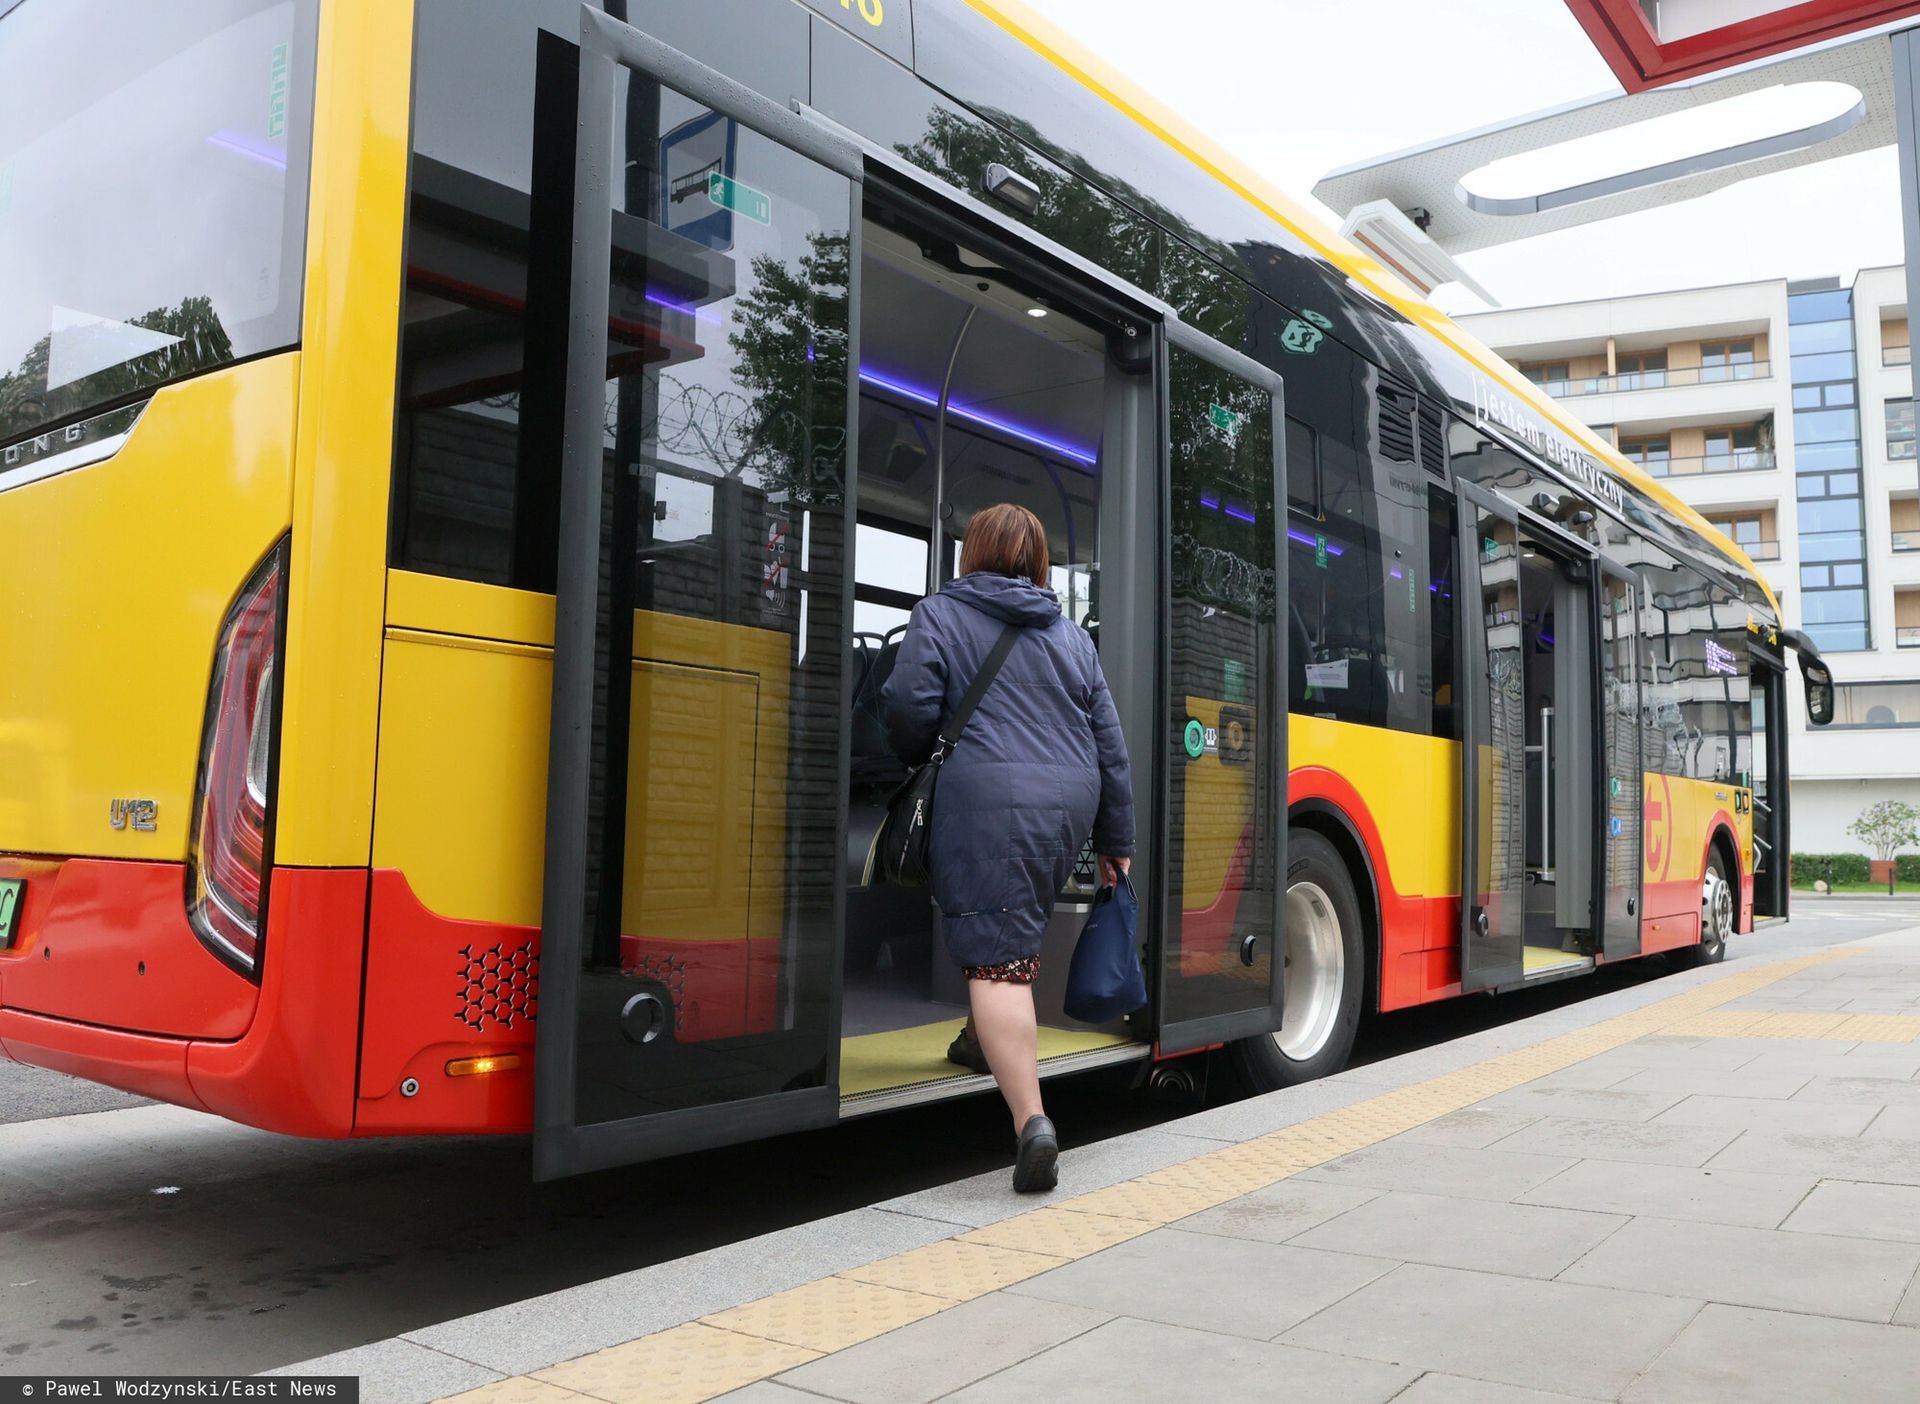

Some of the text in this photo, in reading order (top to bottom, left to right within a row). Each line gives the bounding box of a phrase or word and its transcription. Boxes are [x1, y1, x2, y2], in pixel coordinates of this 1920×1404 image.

[1480, 376, 1624, 514] jestem elektryczny
[111, 799, 158, 831] U12
